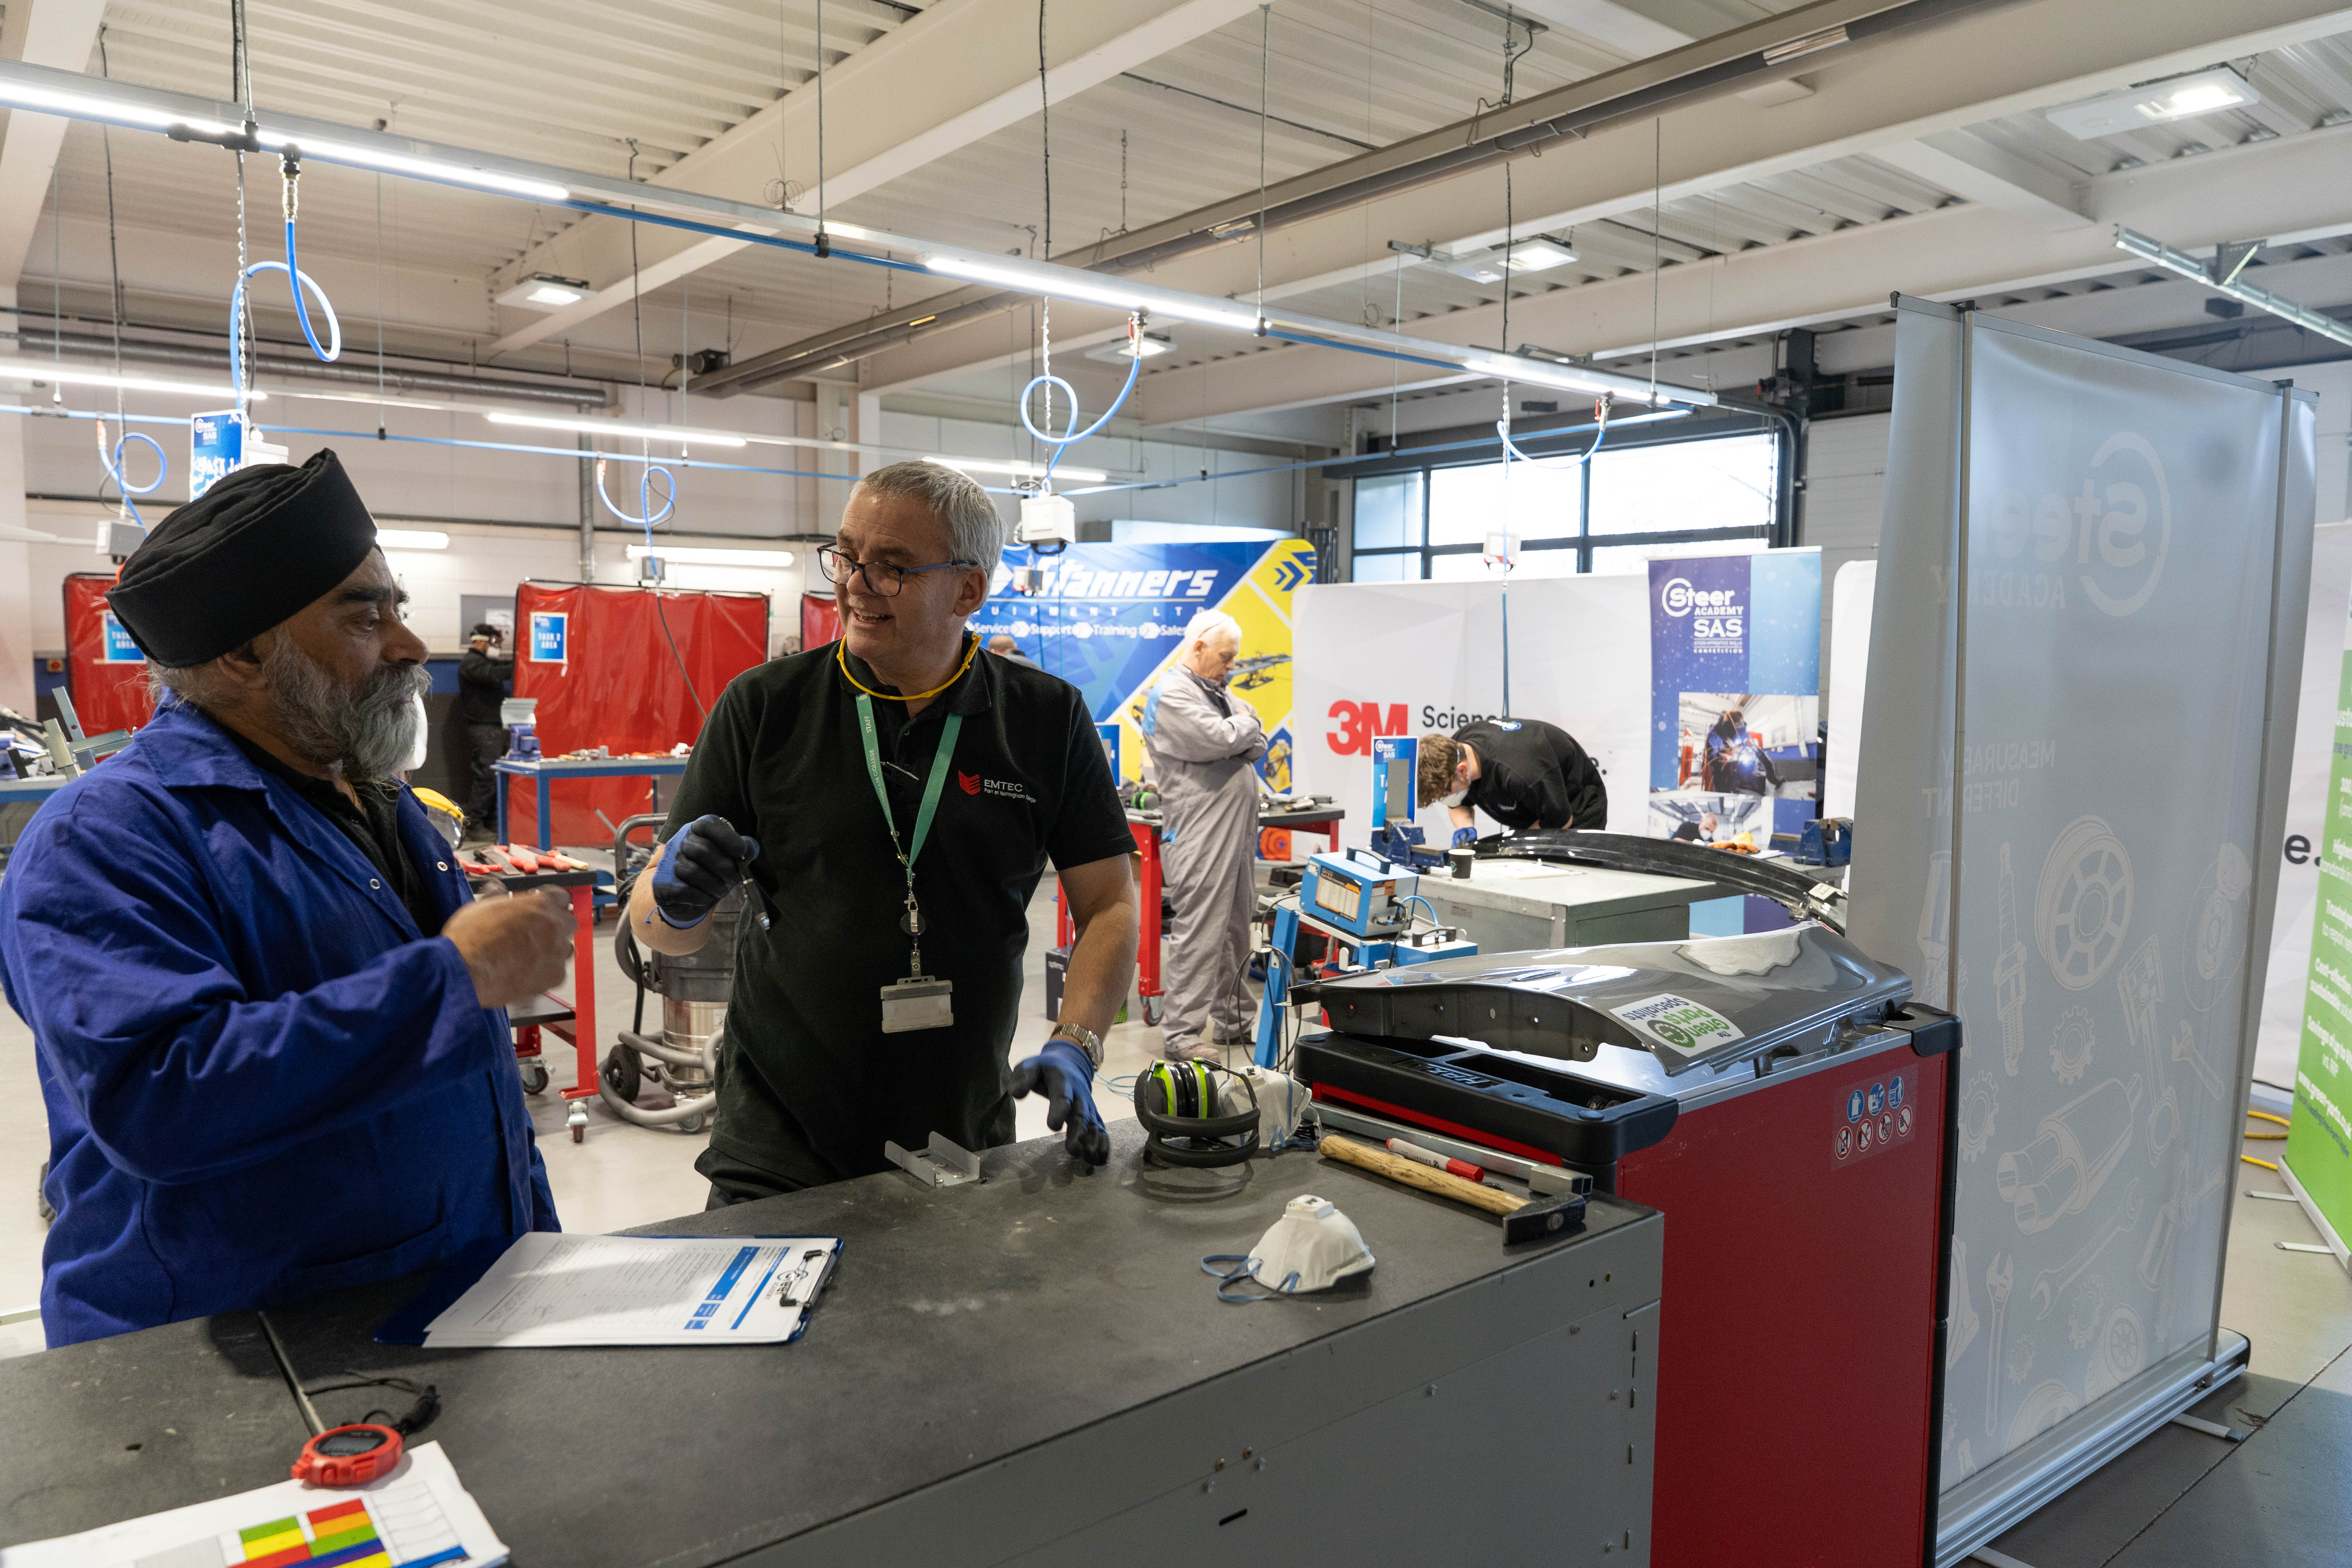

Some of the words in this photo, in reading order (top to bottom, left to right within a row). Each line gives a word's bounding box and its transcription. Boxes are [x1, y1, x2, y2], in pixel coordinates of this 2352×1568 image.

[1031, 556, 1218, 597] Stanners
[975, 606, 1118, 616] UIPMENT
[1693, 606, 1744, 616] ACADEMY
[1030, 623, 1073, 637] Support
[1093, 624, 1138, 639] Training
[1693, 619, 1743, 638] SAS
[1422, 705, 1506, 729] Scien
[1327, 699, 1408, 757] 3M
[869, 749, 878, 776] COLLEGE
[984, 779, 1023, 792] EMTEC
[1622, 997, 1690, 1021] Specialists
[1663, 1006, 1713, 1025] Parts
[1684, 1018, 1730, 1037] Green
[1246, 1067, 1256, 1076] 3M
[1414, 1154, 1431, 1165] banner
